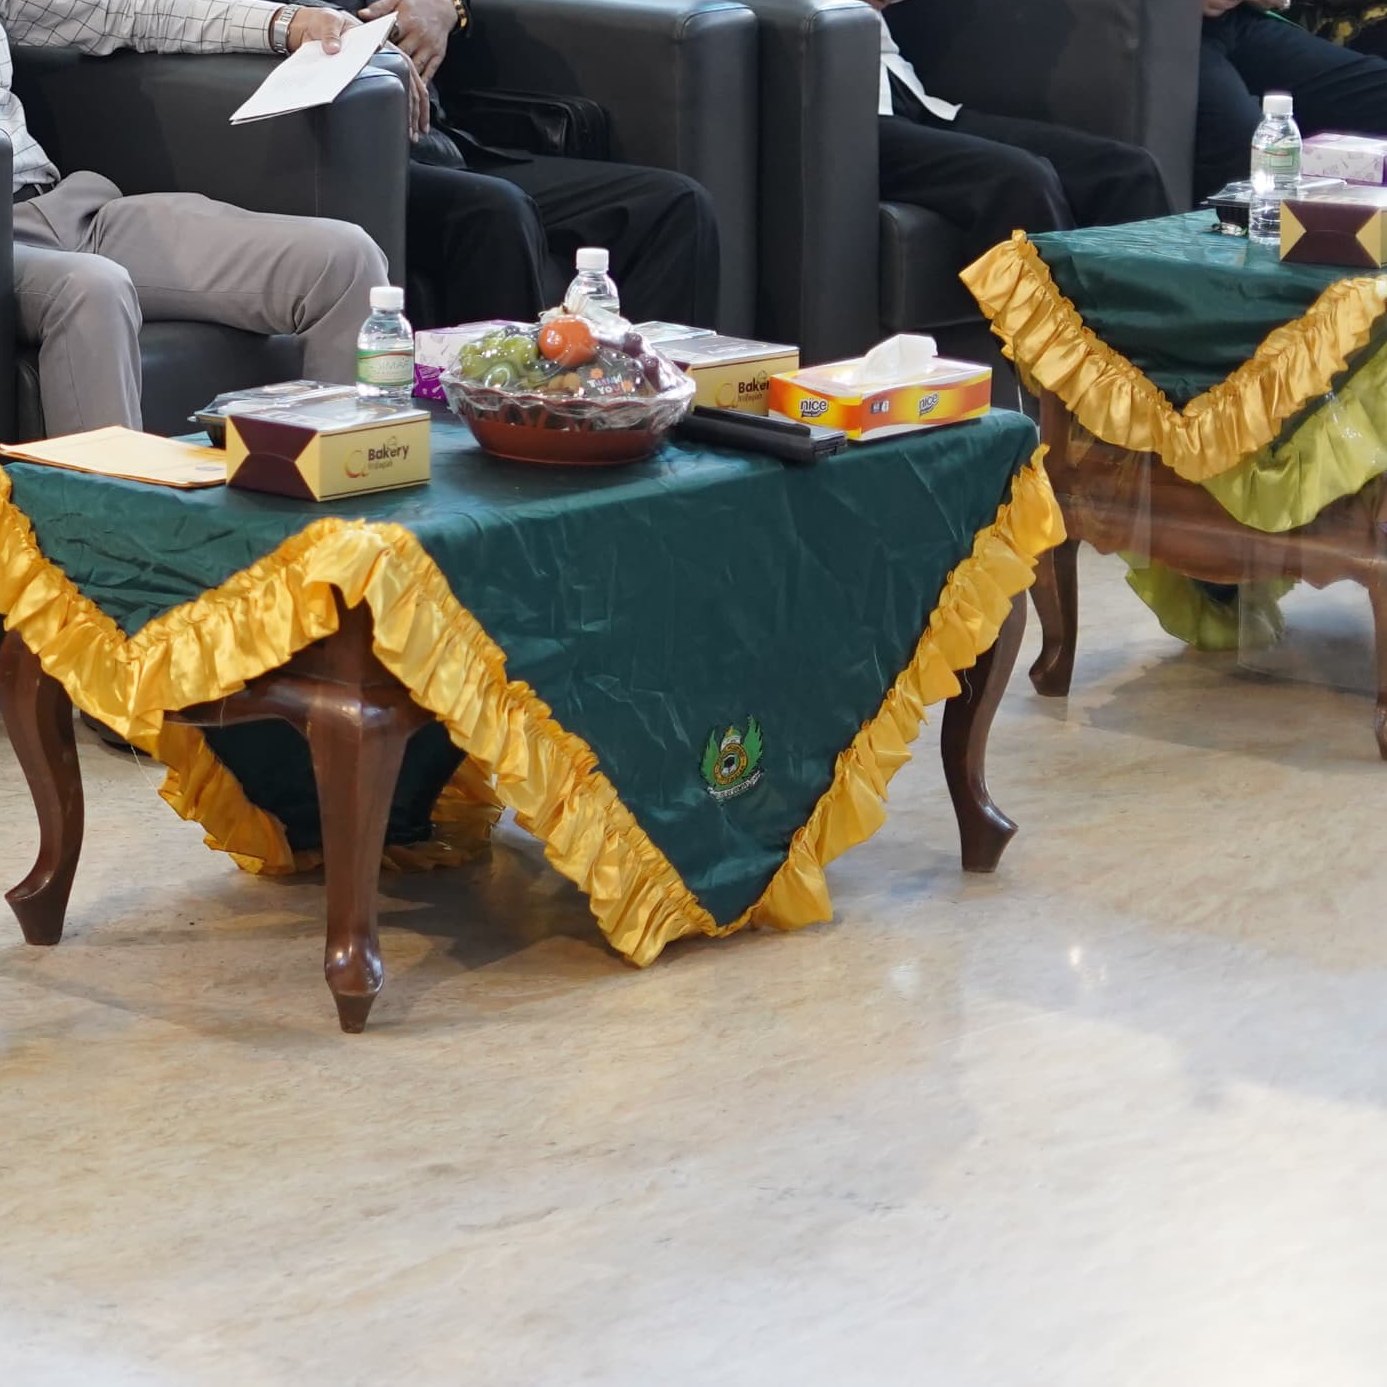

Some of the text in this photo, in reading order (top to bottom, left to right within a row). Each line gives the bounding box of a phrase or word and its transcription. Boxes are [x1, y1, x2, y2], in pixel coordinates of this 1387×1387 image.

[738, 377, 770, 394] Baker
[800, 398, 827, 412] nice
[368, 443, 409, 462] Bakery
